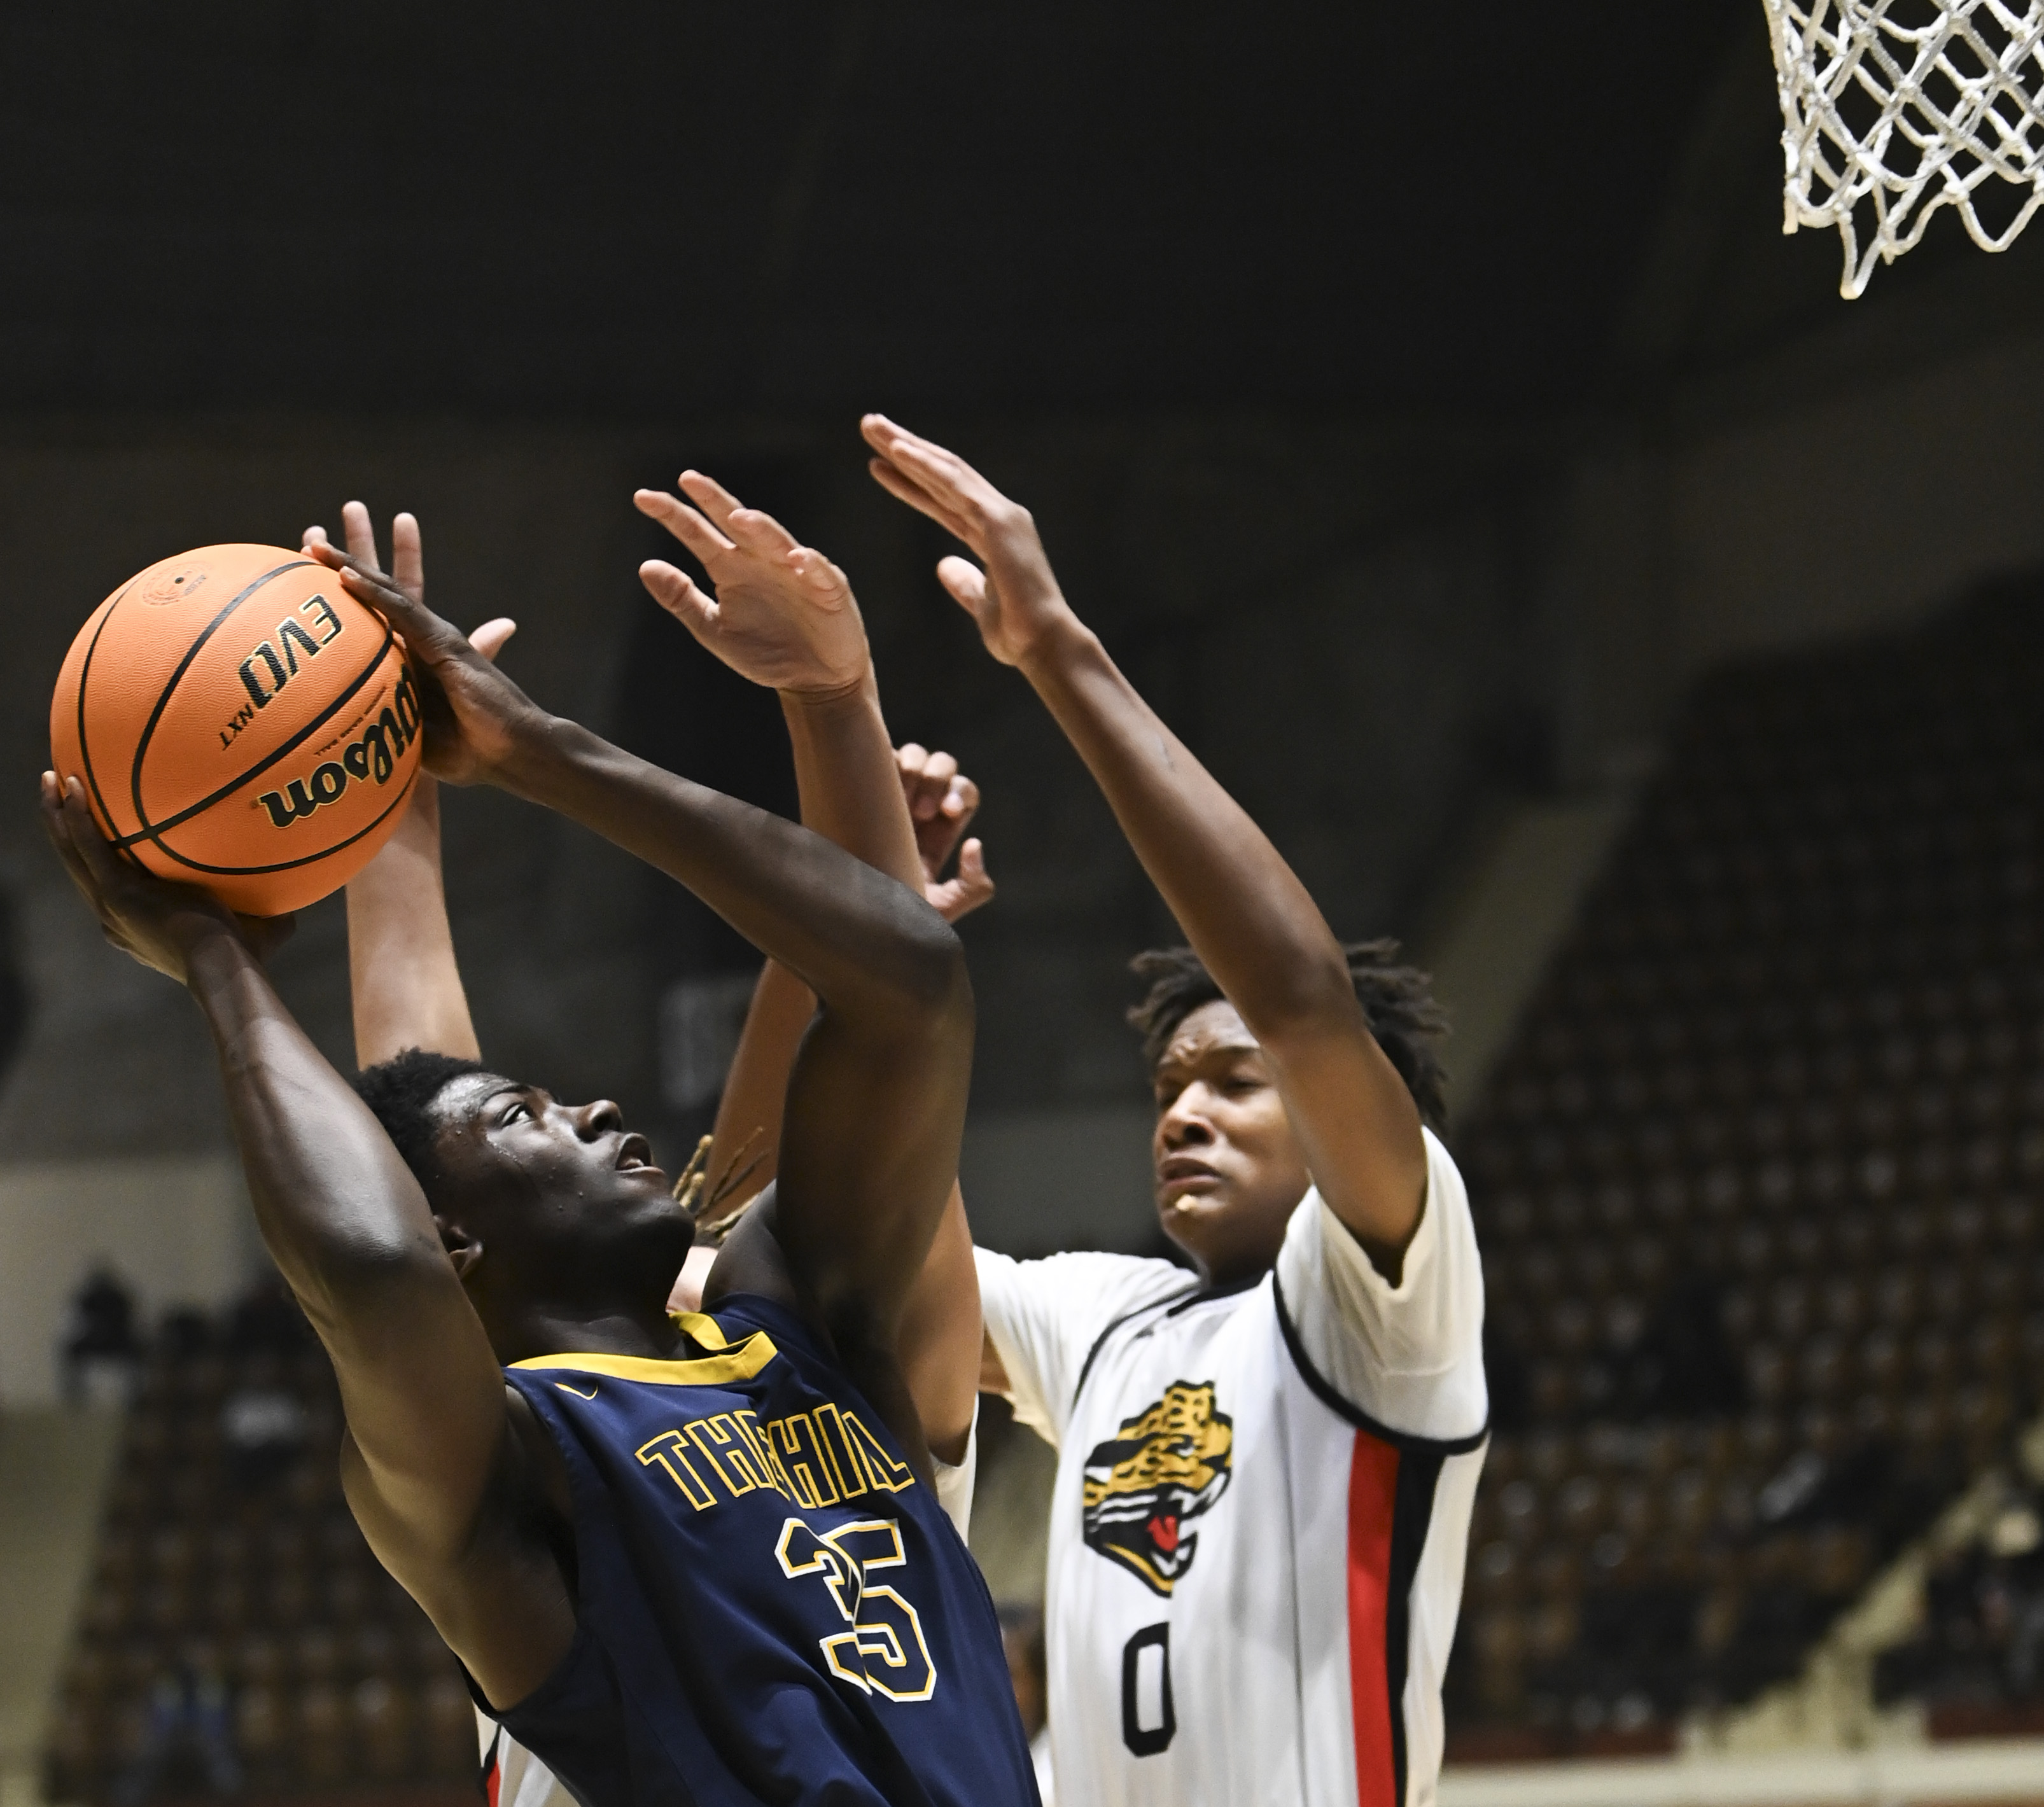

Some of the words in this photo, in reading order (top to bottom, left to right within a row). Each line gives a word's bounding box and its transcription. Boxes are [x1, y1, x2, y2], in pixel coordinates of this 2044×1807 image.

[238, 594, 344, 709] EVO
[219, 704, 254, 751] NXT
[775, 1517, 937, 1703] 35
[1123, 1621, 1177, 1759] 0
